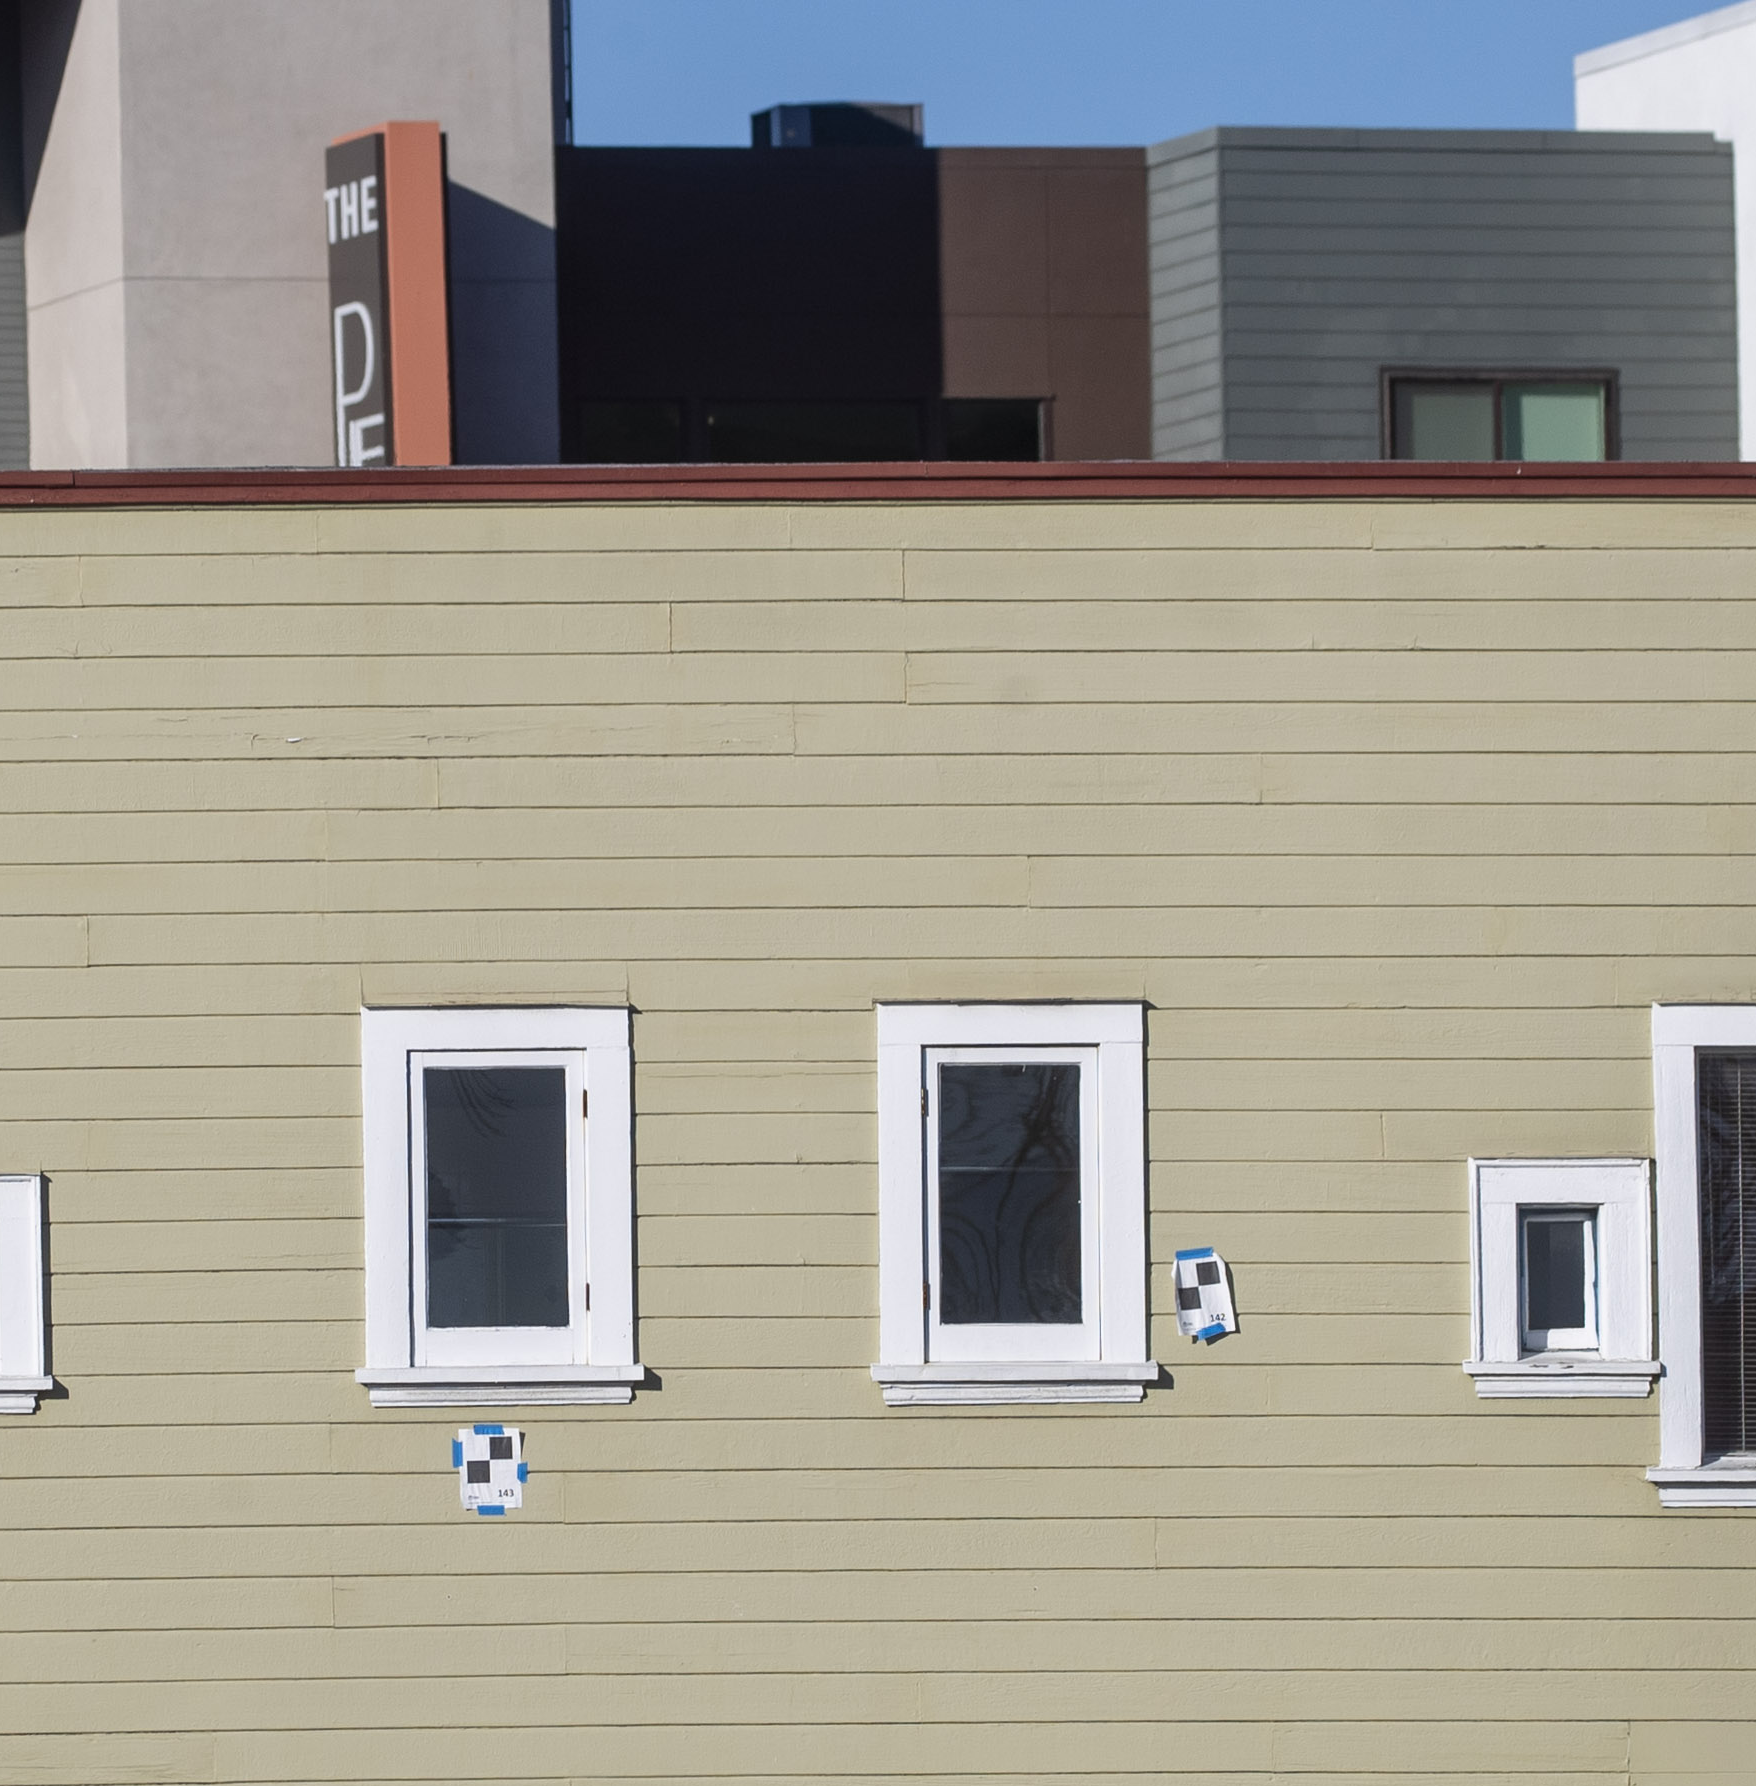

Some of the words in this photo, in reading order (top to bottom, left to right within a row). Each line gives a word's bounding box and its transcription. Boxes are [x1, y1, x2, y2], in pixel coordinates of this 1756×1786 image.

[323, 175, 379, 244] THE
[1210, 1313, 1226, 1322] 142
[498, 1488, 515, 1498] 143
